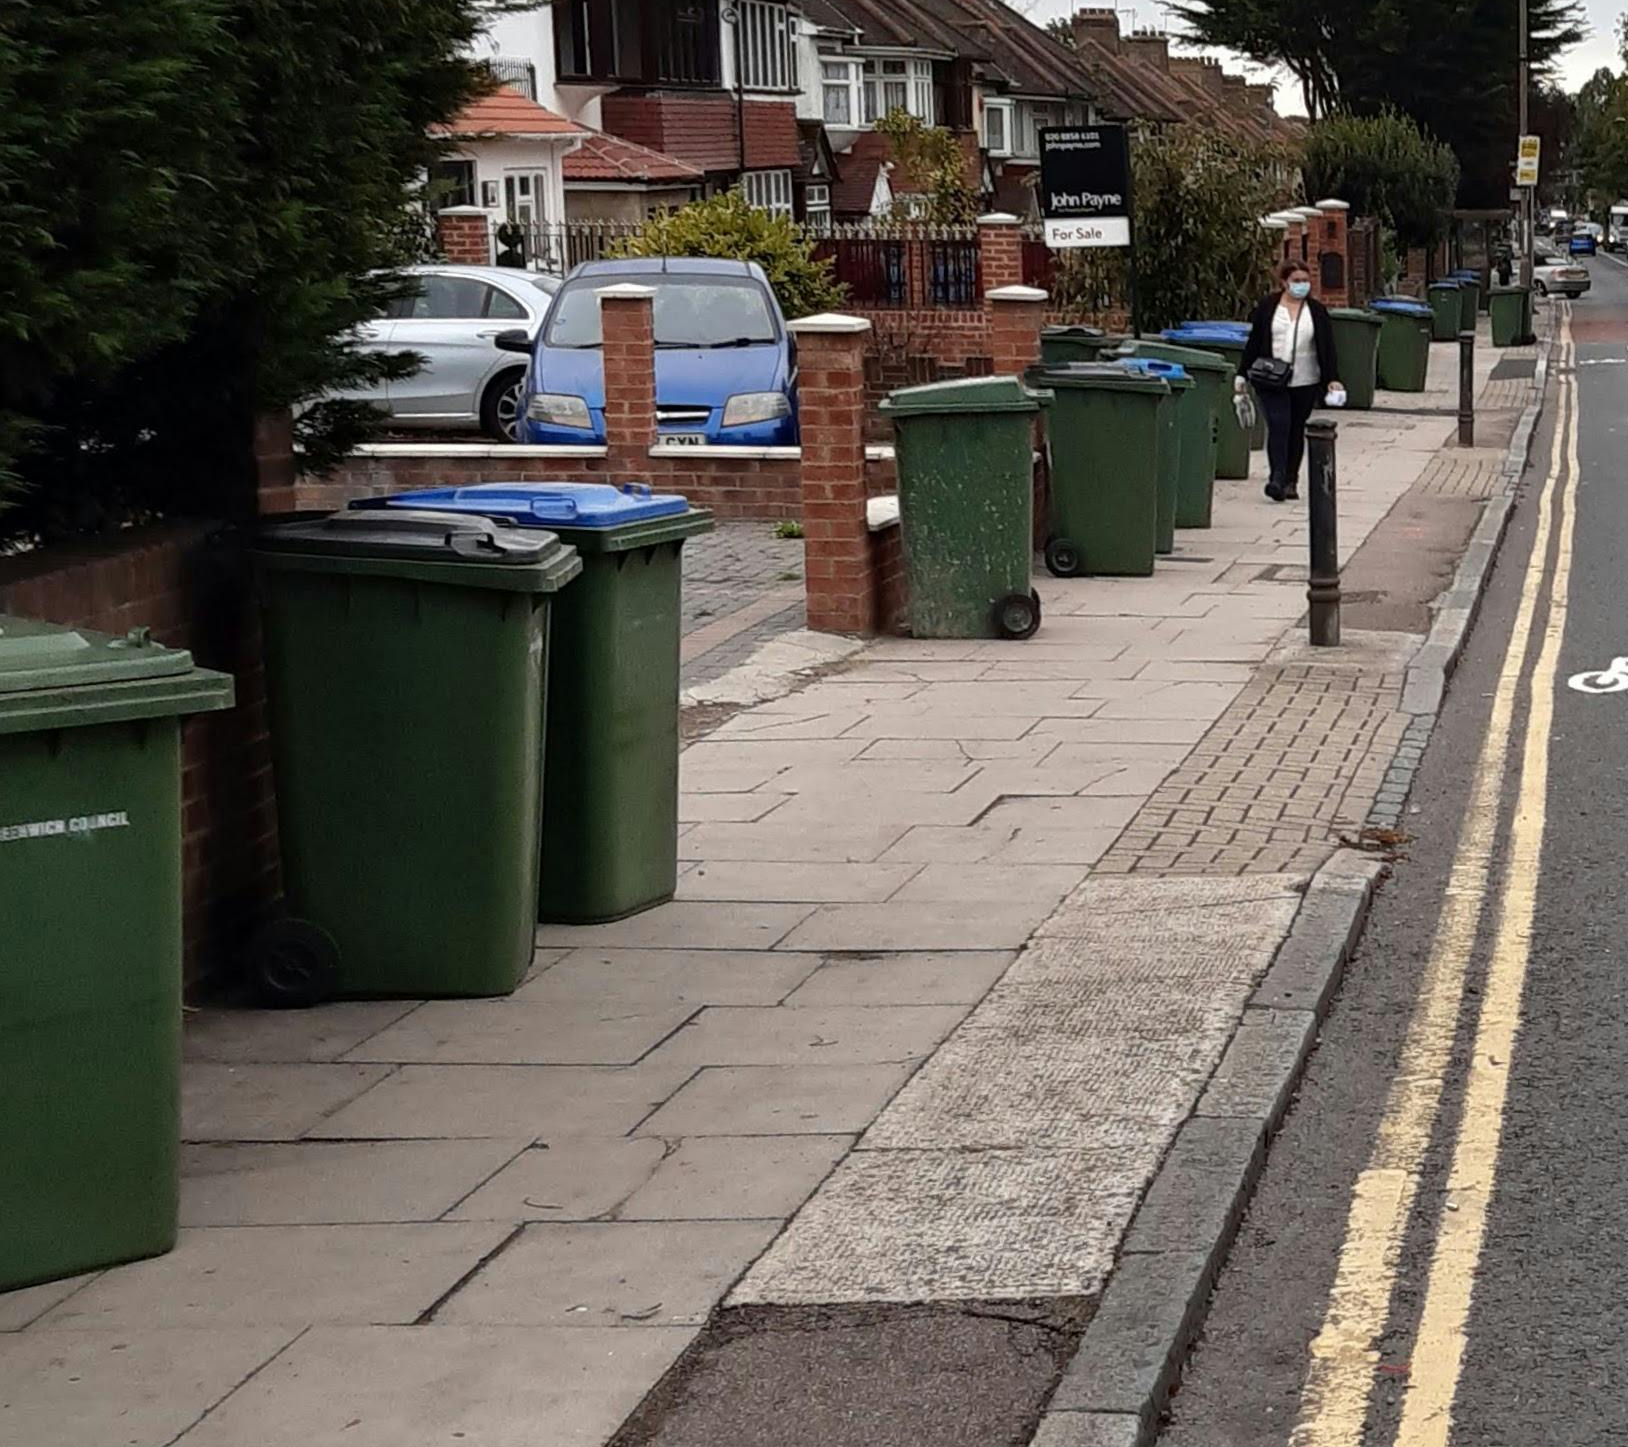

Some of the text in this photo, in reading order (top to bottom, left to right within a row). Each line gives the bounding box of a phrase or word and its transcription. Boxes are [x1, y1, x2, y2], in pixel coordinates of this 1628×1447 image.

[1051, 192, 1122, 211] John Payne
[1052, 227, 1102, 240] For Sale
[69, 812, 130, 831] COUNCIL
